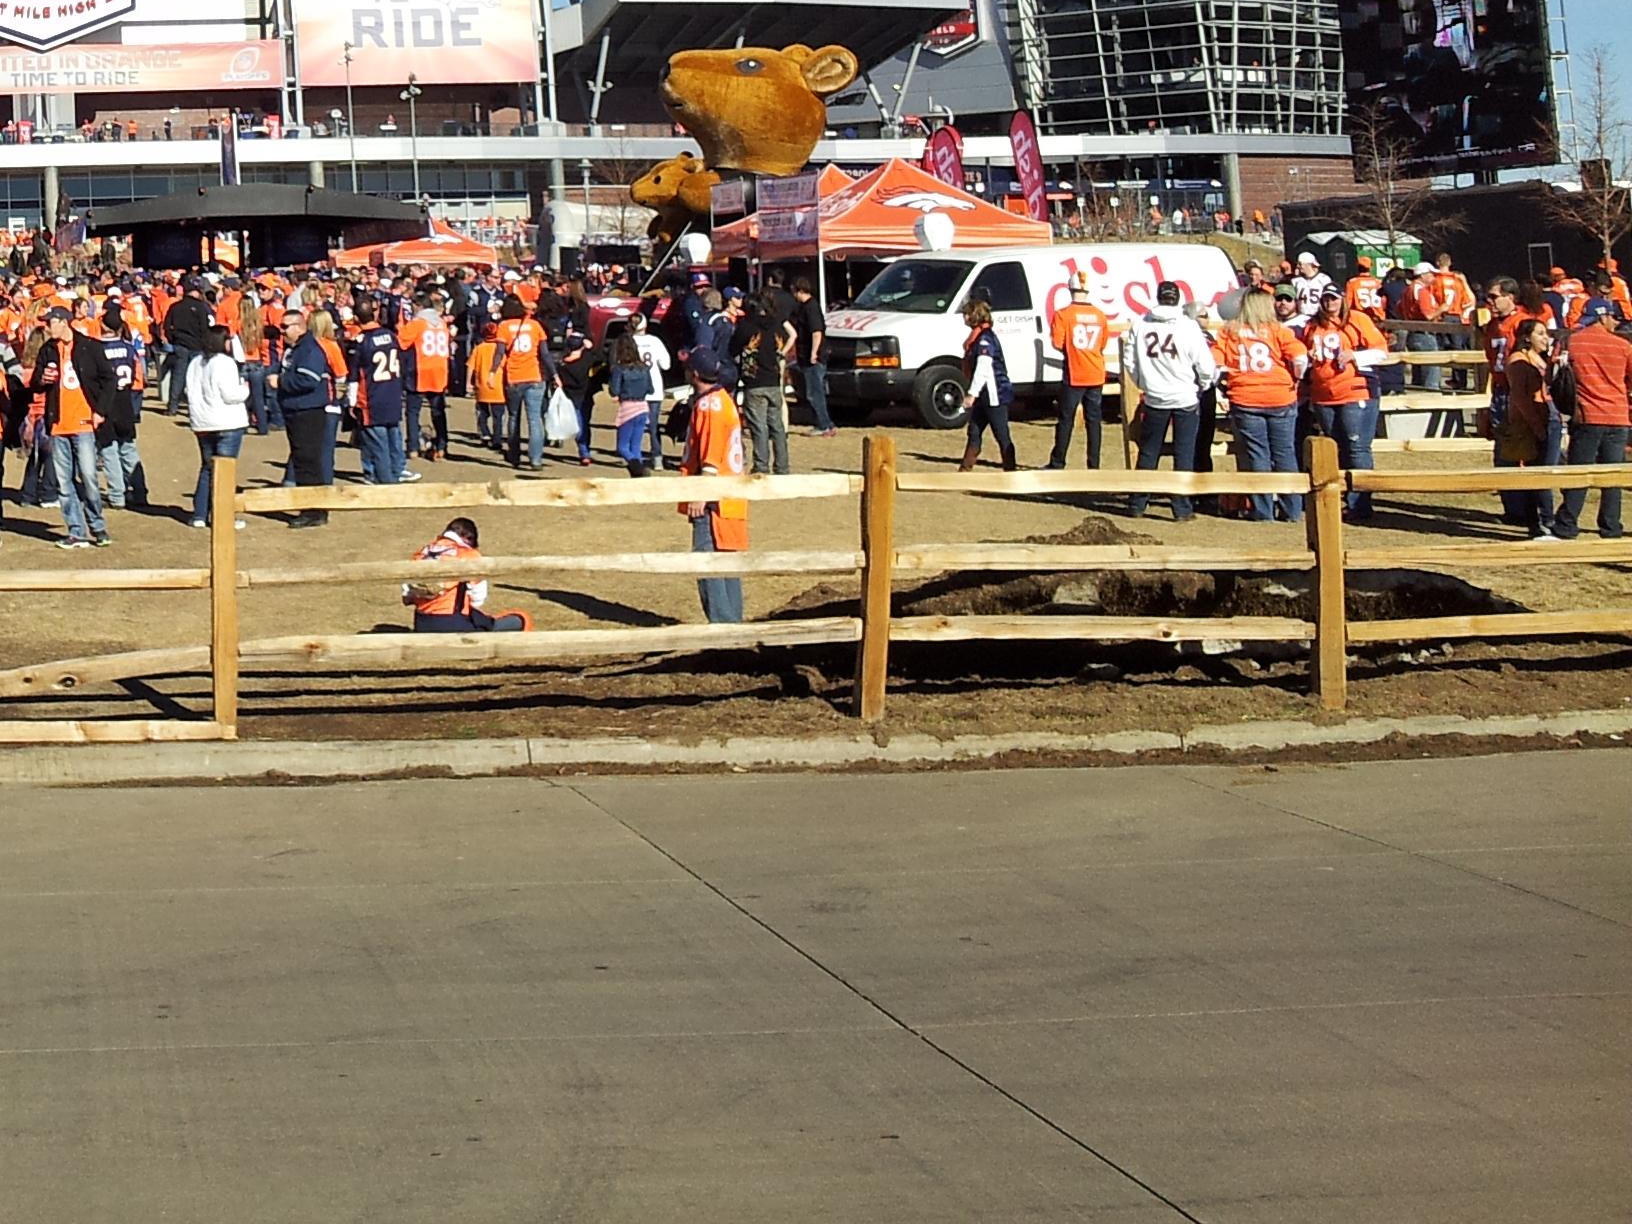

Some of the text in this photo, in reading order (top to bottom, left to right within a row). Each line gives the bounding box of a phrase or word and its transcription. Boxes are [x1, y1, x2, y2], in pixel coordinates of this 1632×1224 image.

[13, 5, 51, 19] MILE
[352, 7, 482, 48] RIDE
[58, 53, 79, 69] IN
[86, 50, 183, 69] ORANGE
[11, 71, 139, 87] TIME TO RIDE
[422, 331, 449, 357] 88
[1072, 324, 1102, 350] 87
[1145, 331, 1179, 359] 24
[372, 351, 400, 381] 24
[1236, 343, 1273, 373] 18
